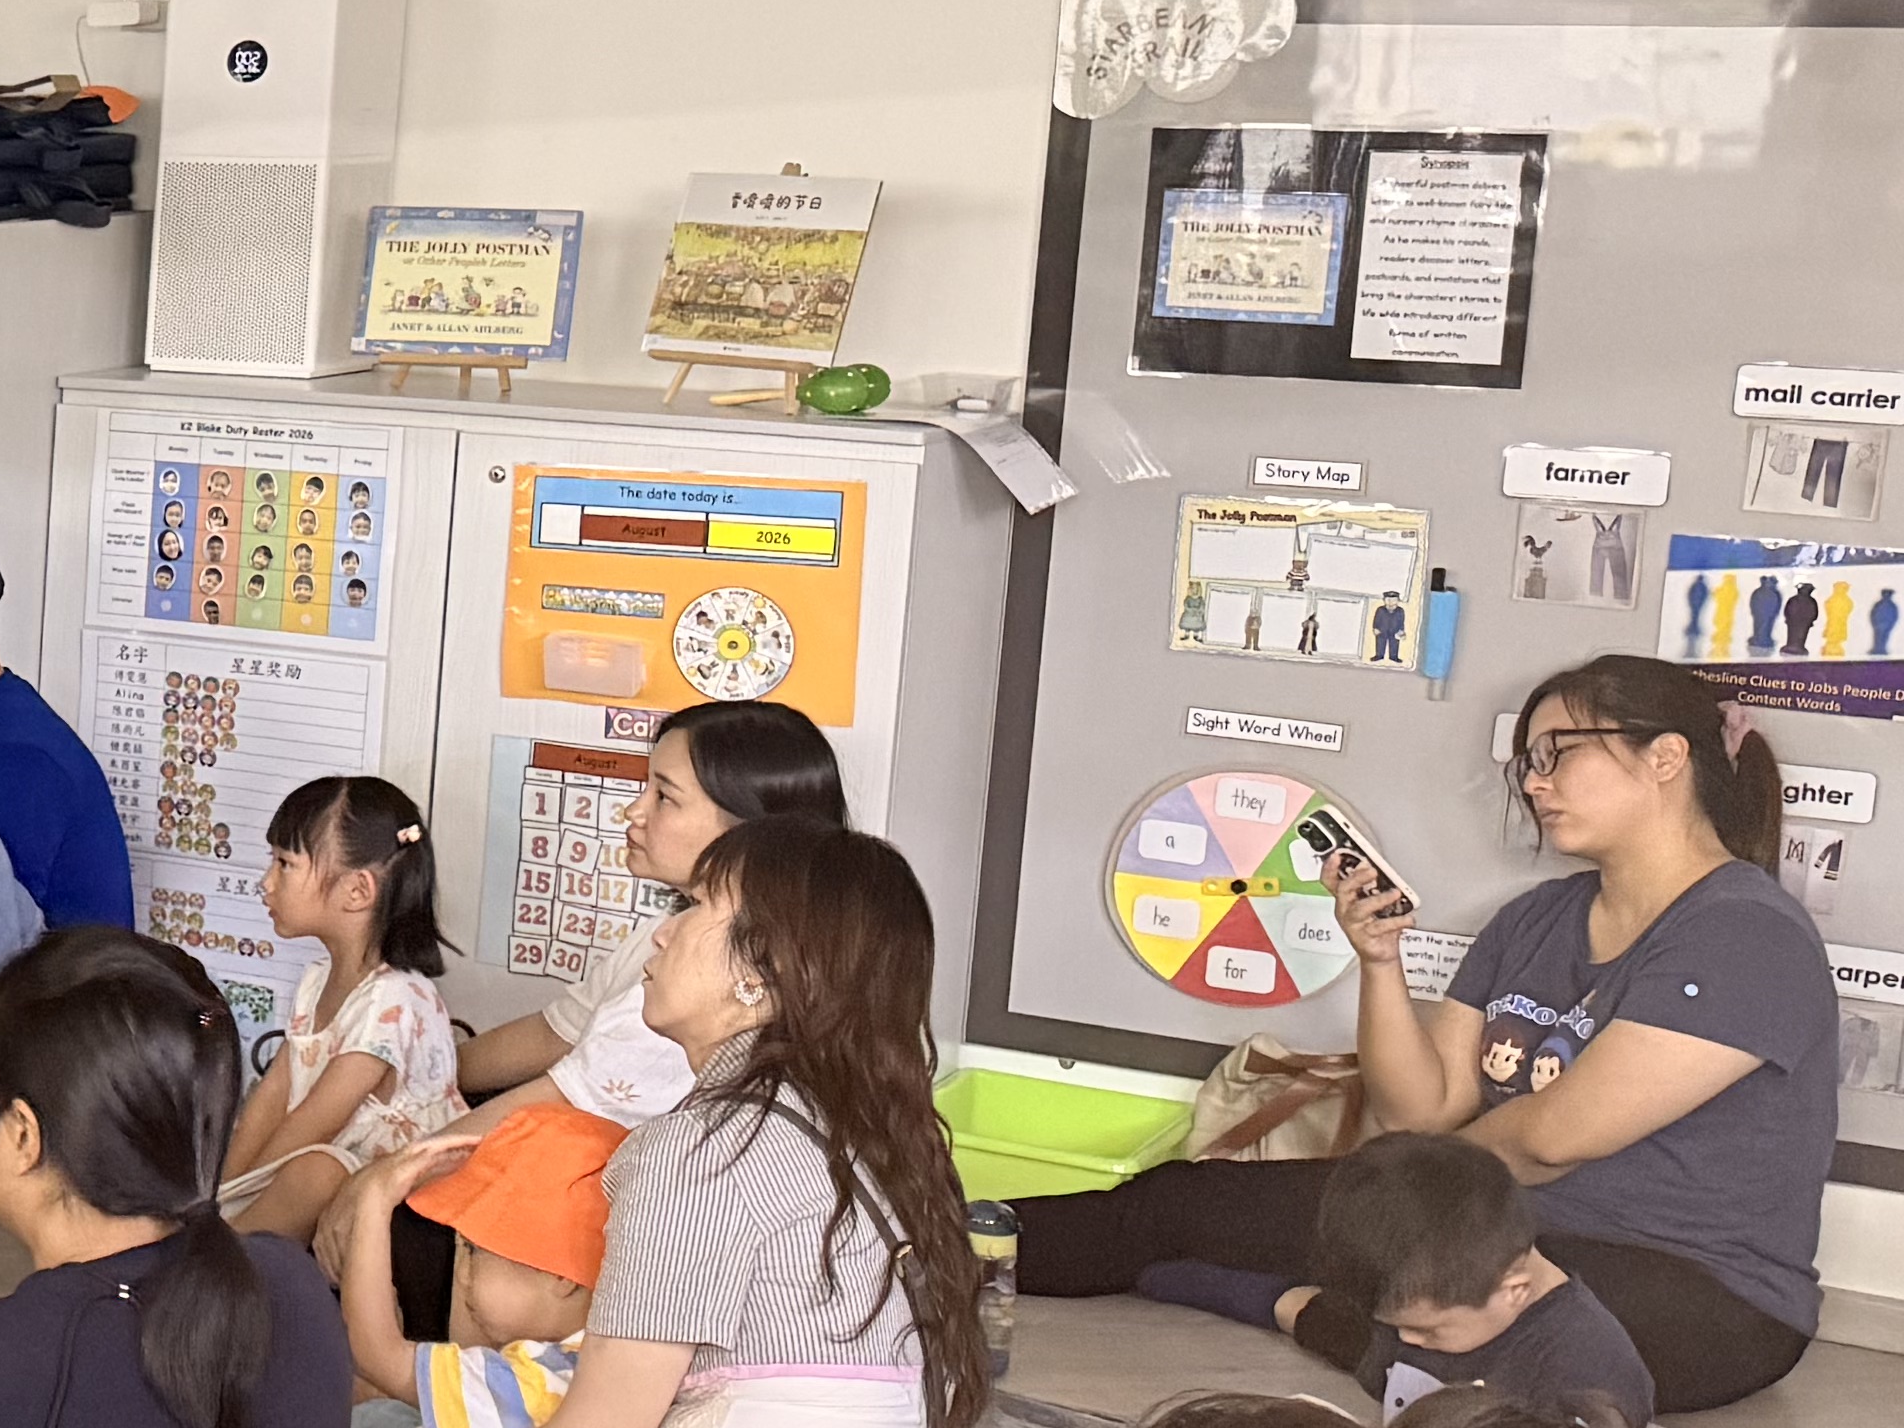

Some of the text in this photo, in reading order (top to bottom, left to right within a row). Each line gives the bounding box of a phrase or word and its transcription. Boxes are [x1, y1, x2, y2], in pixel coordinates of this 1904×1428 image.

[1182, 221, 1323, 237] THE JOLLY POSTMAN
[386, 240, 551, 257] THE JOLLY POSTMAN
[389, 322, 423, 333] JANET
[1744, 383, 1902, 410] mail carrier
[226, 424, 249, 437] Duty
[1265, 462, 1351, 486] Story Map
[1545, 462, 1631, 487] farmer
[619, 485, 718, 506] The date today
[1196, 508, 1218, 521] The
[621, 522, 667, 540] August
[756, 530, 792, 546] 2026
[229, 657, 303, 681] 星星奖励
[115, 688, 145, 701] Alina
[1749, 675, 1787, 691] Clues
[1790, 679, 1806, 693] to
[1808, 681, 1839, 696] Jobs
[1843, 683, 1892, 700] People
[1737, 690, 1842, 712] Content Words
[1192, 711, 1338, 745] Sight Word Wheel
[535, 792, 547, 816] 1
[574, 795, 592, 820] 2
[1232, 787, 1268, 820] they
[530, 835, 550, 859] 8
[569, 840, 588, 864] 9
[1165, 833, 1176, 849] a
[521, 868, 551, 894] 15
[563, 872, 593, 898] 16
[598, 880, 629, 904] 17
[517, 903, 629, 942] 22 23 24
[1153, 905, 1171, 928] he
[1298, 922, 1332, 943] does
[1426, 935, 1443, 946] the
[513, 942, 583, 973] 29 30
[1406, 951, 1434, 962] write
[1224, 958, 1248, 981] for
[1406, 967, 1449, 980] with the
